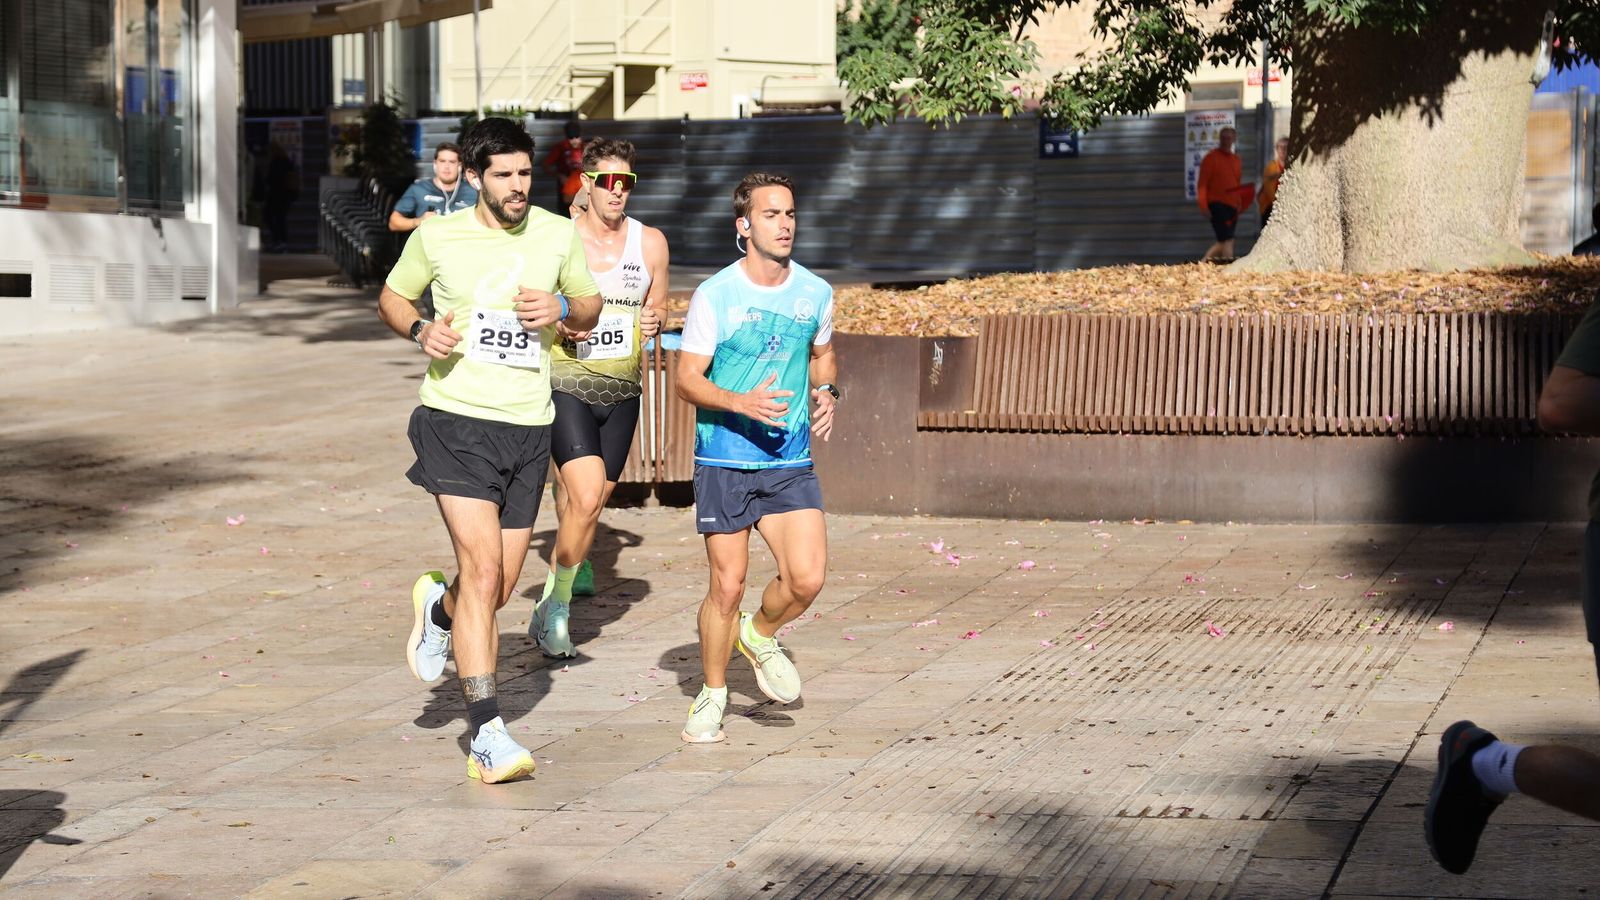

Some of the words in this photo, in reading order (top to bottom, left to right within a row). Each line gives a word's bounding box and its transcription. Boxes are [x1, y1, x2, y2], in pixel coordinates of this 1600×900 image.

[623, 262, 641, 272] vive
[615, 297, 642, 307] MÁLAG
[479, 328, 529, 350] 293
[587, 330, 624, 346] 505
